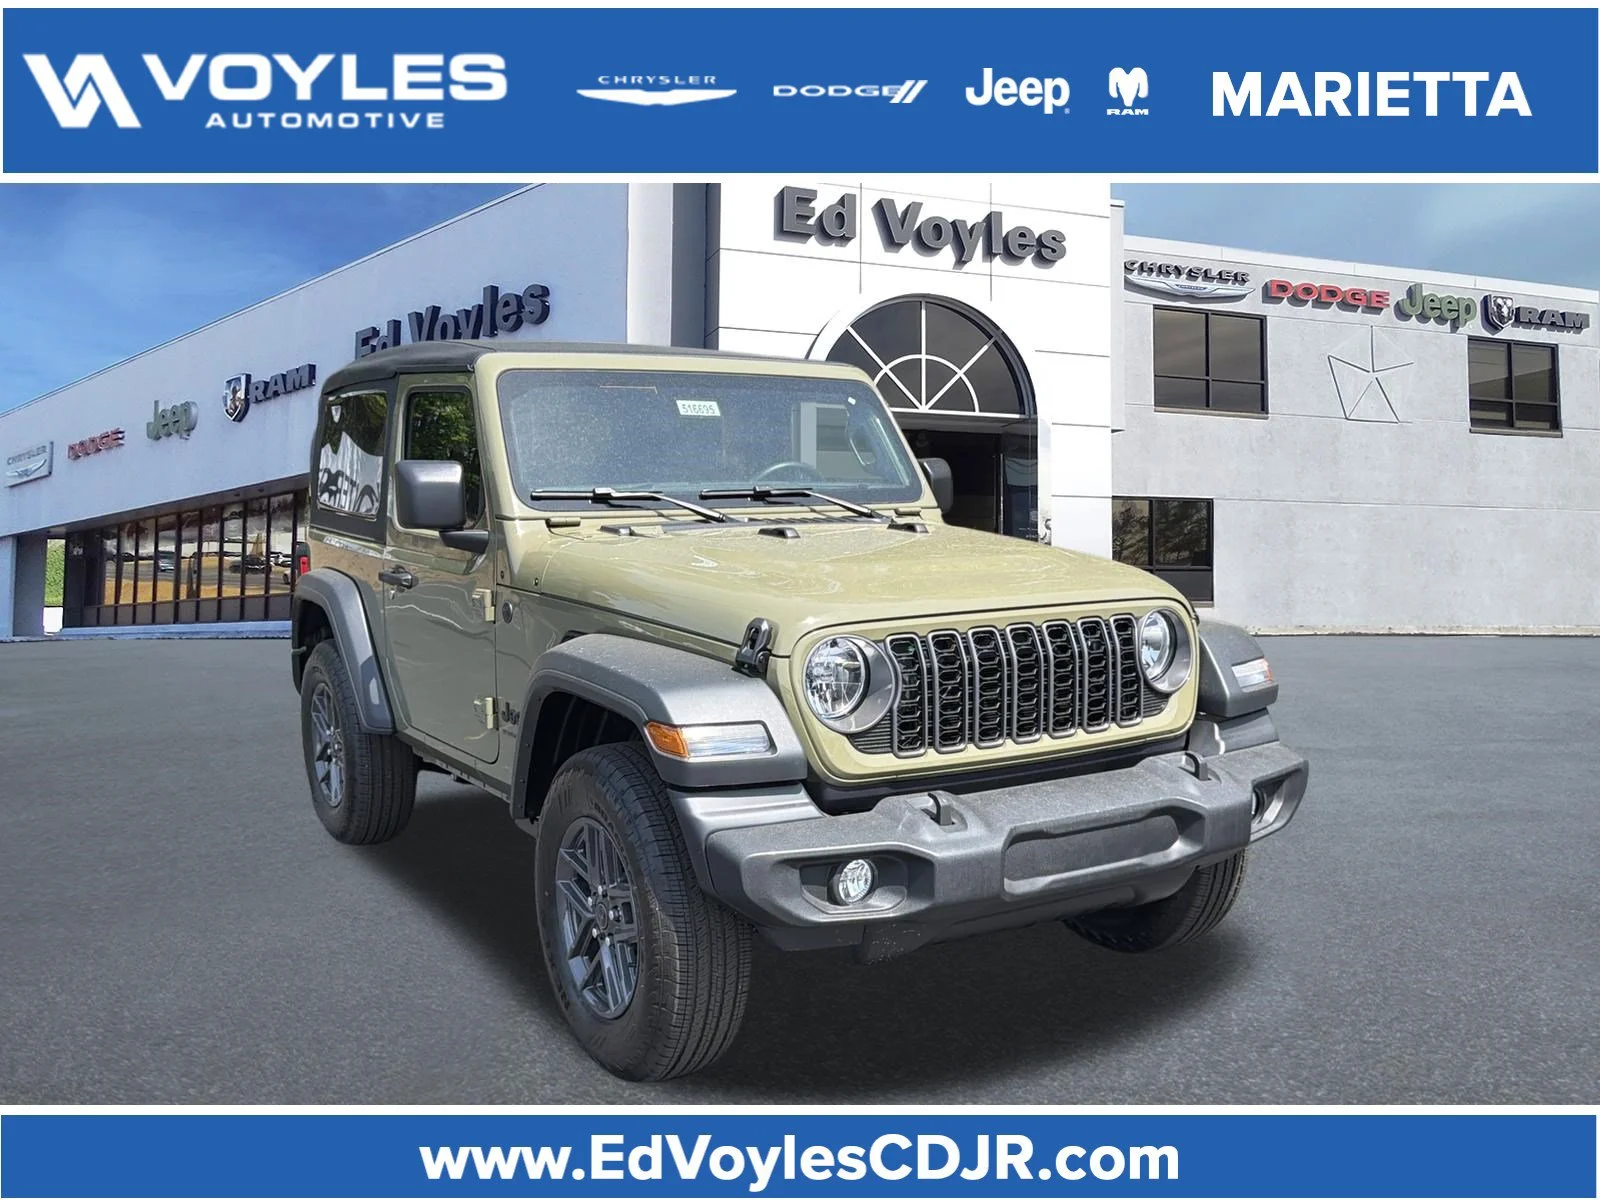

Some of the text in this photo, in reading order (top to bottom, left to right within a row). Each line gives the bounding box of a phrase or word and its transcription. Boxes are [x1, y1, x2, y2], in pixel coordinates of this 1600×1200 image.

[774, 186, 1067, 270] Ed Voyles
[1124, 259, 1250, 286] CHRYSLER
[1262, 279, 1390, 315] DODGE
[1394, 283, 1477, 334] Jeep
[355, 284, 550, 360] Ed Voyles
[1514, 306, 1591, 334] RAM
[249, 364, 316, 404] RAM
[146, 400, 198, 440] Jeep
[7, 445, 48, 465] CHRYSLER
[68, 427, 125, 461] DODGE
